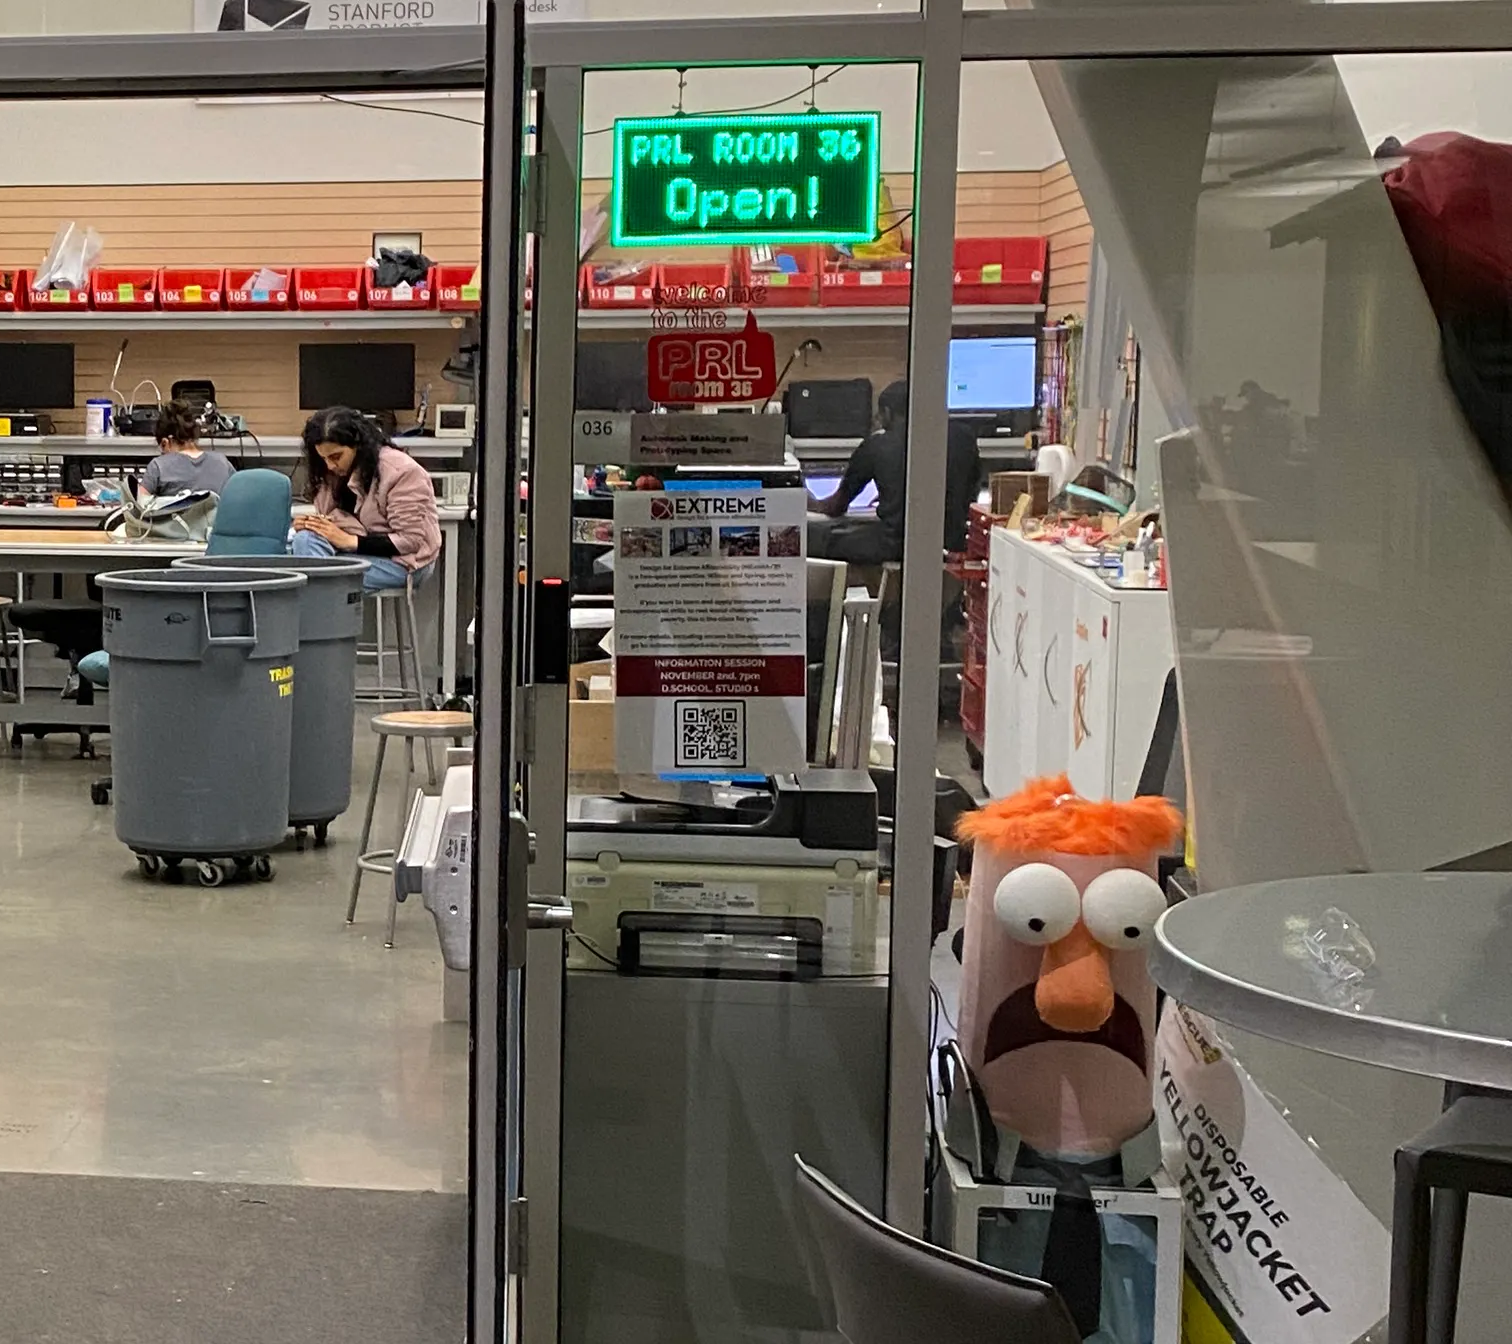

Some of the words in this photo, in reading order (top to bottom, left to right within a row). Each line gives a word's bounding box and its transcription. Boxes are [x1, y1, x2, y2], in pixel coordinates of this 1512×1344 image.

[328, 1, 435, 21] STANFORD
[631, 133, 694, 167] PRL
[712, 131, 799, 166] ROOM
[817, 129, 861, 162] 36
[665, 175, 820, 229] Open!
[29, 290, 48, 302] 102
[95, 290, 114, 302] 103
[161, 290, 180, 302] 104
[228, 290, 247, 302] 105
[298, 290, 317, 302] 106
[368, 290, 388, 302] 107
[438, 290, 458, 302] 108
[590, 288, 610, 299] 110
[749, 275, 770, 286] 225
[652, 281, 768, 305] welcome
[651, 307, 678, 330] to
[684, 306, 728, 330] the
[657, 339, 763, 381] PRL
[669, 381, 725, 398] room
[731, 381, 753, 397] 36
[582, 420, 613, 437] 036
[675, 497, 766, 514] EXTREME
[654, 659, 722, 668] INFORMATION
[724, 658, 766, 667] SESSION
[660, 671, 715, 680] NOVEMBER
[739, 672, 761, 682] 7pm
[715, 684, 751, 693] STUDIO
[1194, 1103, 1290, 1229] DISPOSABLE
[1161, 1058, 1332, 1318] YELLOWJACKET
[1179, 1163, 1234, 1255] TRAP
